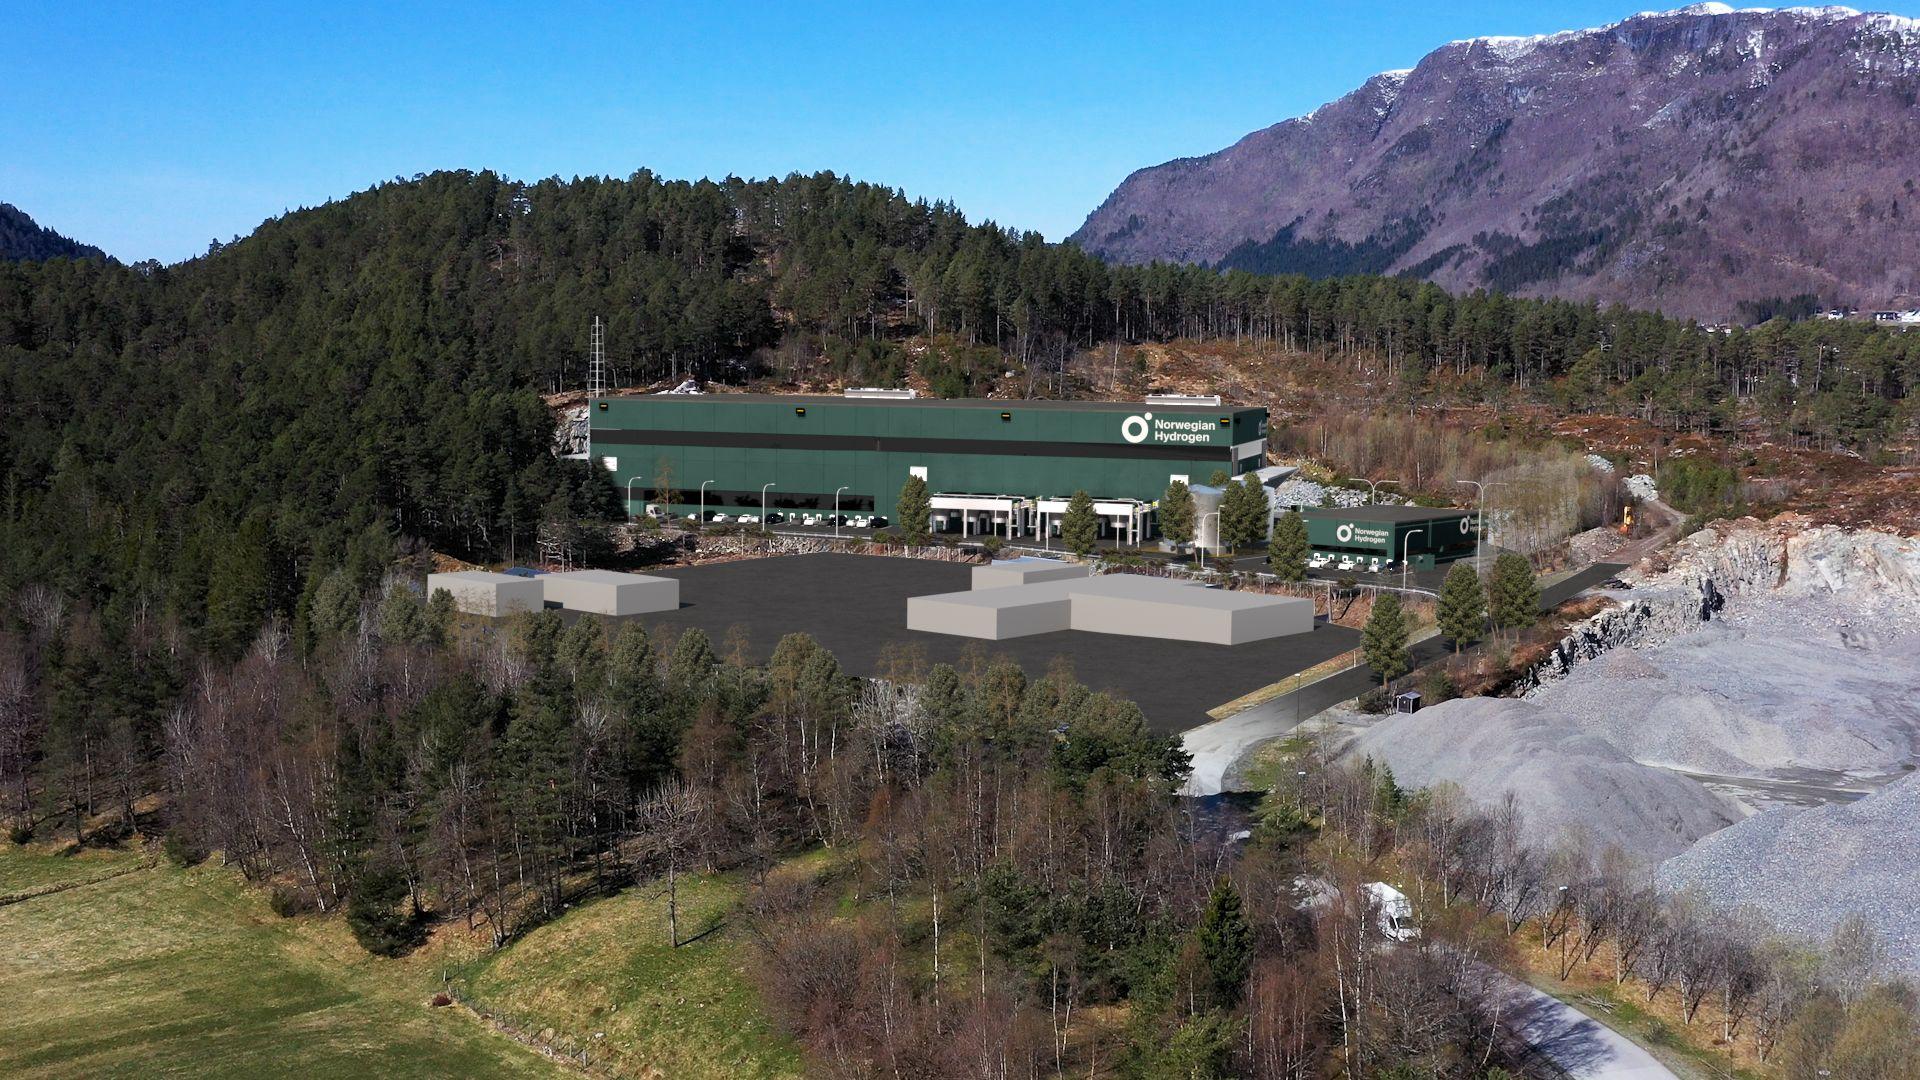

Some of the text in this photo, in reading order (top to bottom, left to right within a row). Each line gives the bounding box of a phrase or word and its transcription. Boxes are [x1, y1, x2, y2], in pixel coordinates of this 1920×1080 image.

[1154, 420, 1216, 432] Norwegian
[1154, 431, 1210, 444] Hydrogen
[1354, 528, 1388, 536] Norwegian
[1354, 535, 1386, 544] Hydrogen
